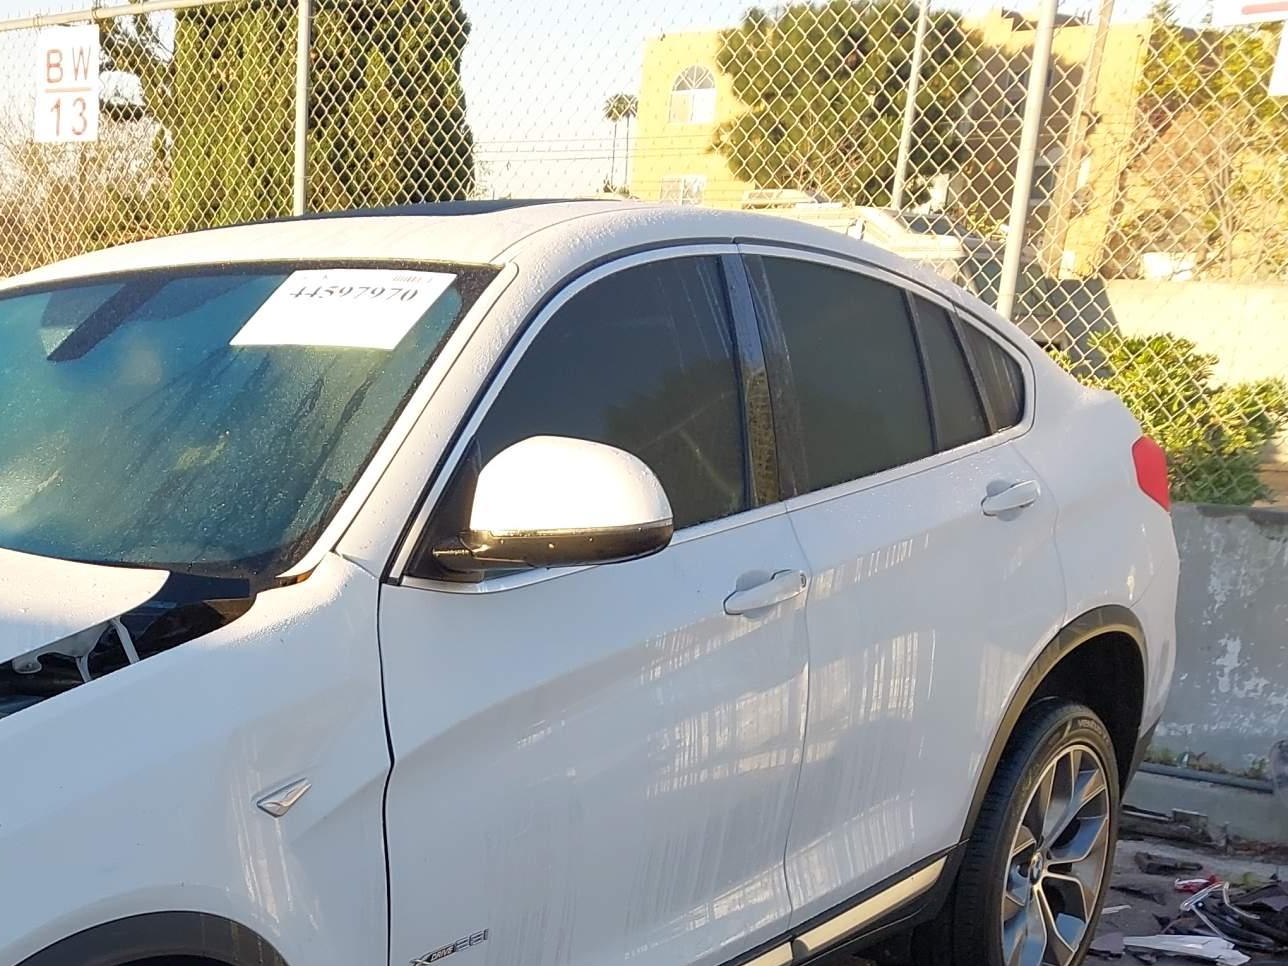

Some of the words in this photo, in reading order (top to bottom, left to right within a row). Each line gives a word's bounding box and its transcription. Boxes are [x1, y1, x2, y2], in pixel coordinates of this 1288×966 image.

[46, 46, 91, 83] BW
[50, 97, 87, 136] 13
[289, 286, 418, 301] 44597970
